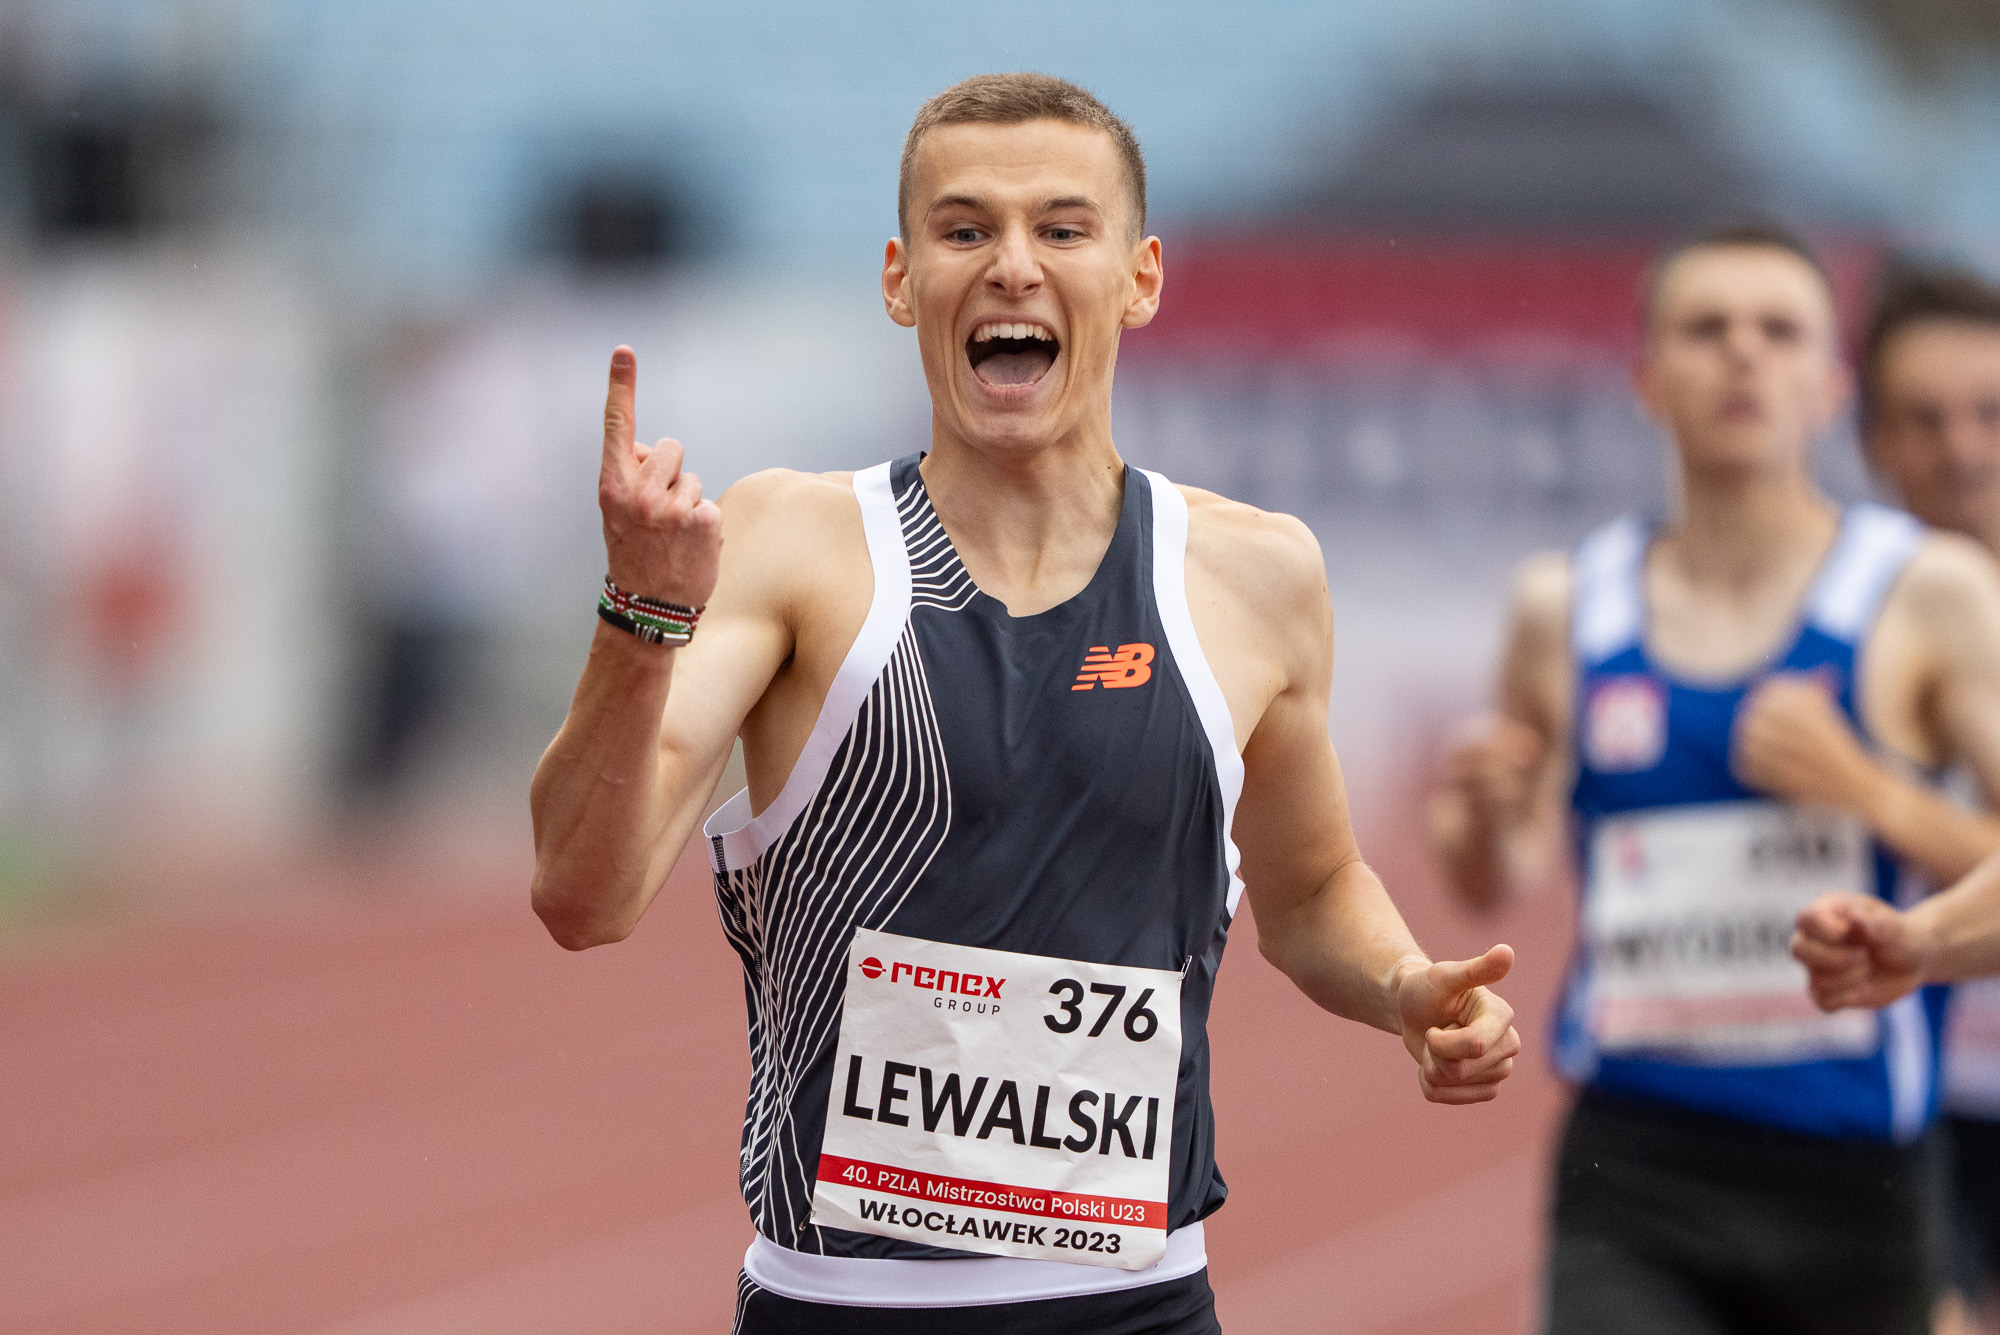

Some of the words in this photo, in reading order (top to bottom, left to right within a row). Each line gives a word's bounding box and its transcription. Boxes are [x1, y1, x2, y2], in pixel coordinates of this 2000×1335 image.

[1071, 642, 1155, 691] NB
[890, 961, 1007, 999] renex
[933, 997, 1001, 1016] GROUP
[1043, 978, 1159, 1042] 376
[842, 1054, 1160, 1160] LEWALSKI
[842, 1165, 872, 1186] 40.
[877, 1171, 921, 1195] PZLA
[925, 1180, 1045, 1213] Mistrzostwa
[1050, 1198, 1105, 1219] Polski
[1110, 1203, 1146, 1223] U23
[859, 1198, 1048, 1247] WŁOCŁAWEK
[1053, 1227, 1122, 1255] 2023
